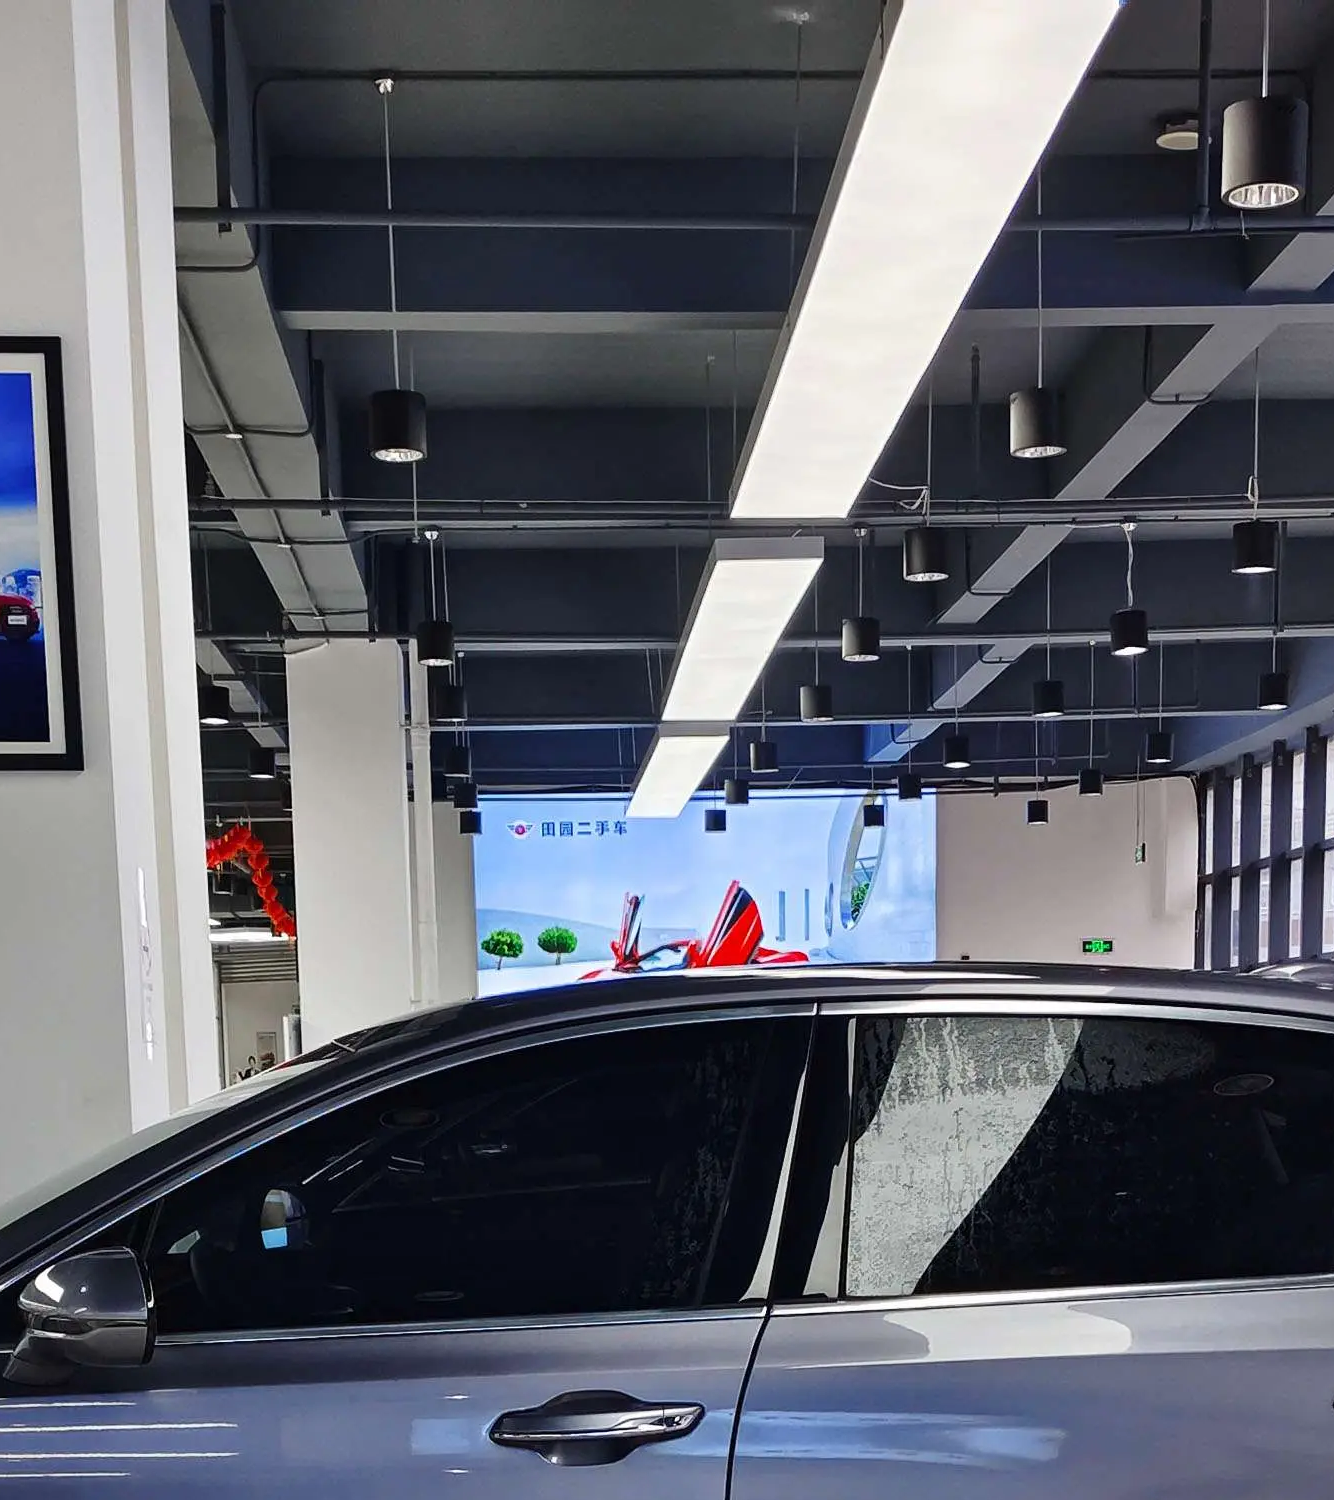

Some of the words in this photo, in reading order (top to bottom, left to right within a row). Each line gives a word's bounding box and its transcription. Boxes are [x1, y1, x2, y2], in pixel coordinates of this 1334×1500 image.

[541, 820, 627, 837] 田园二手车
